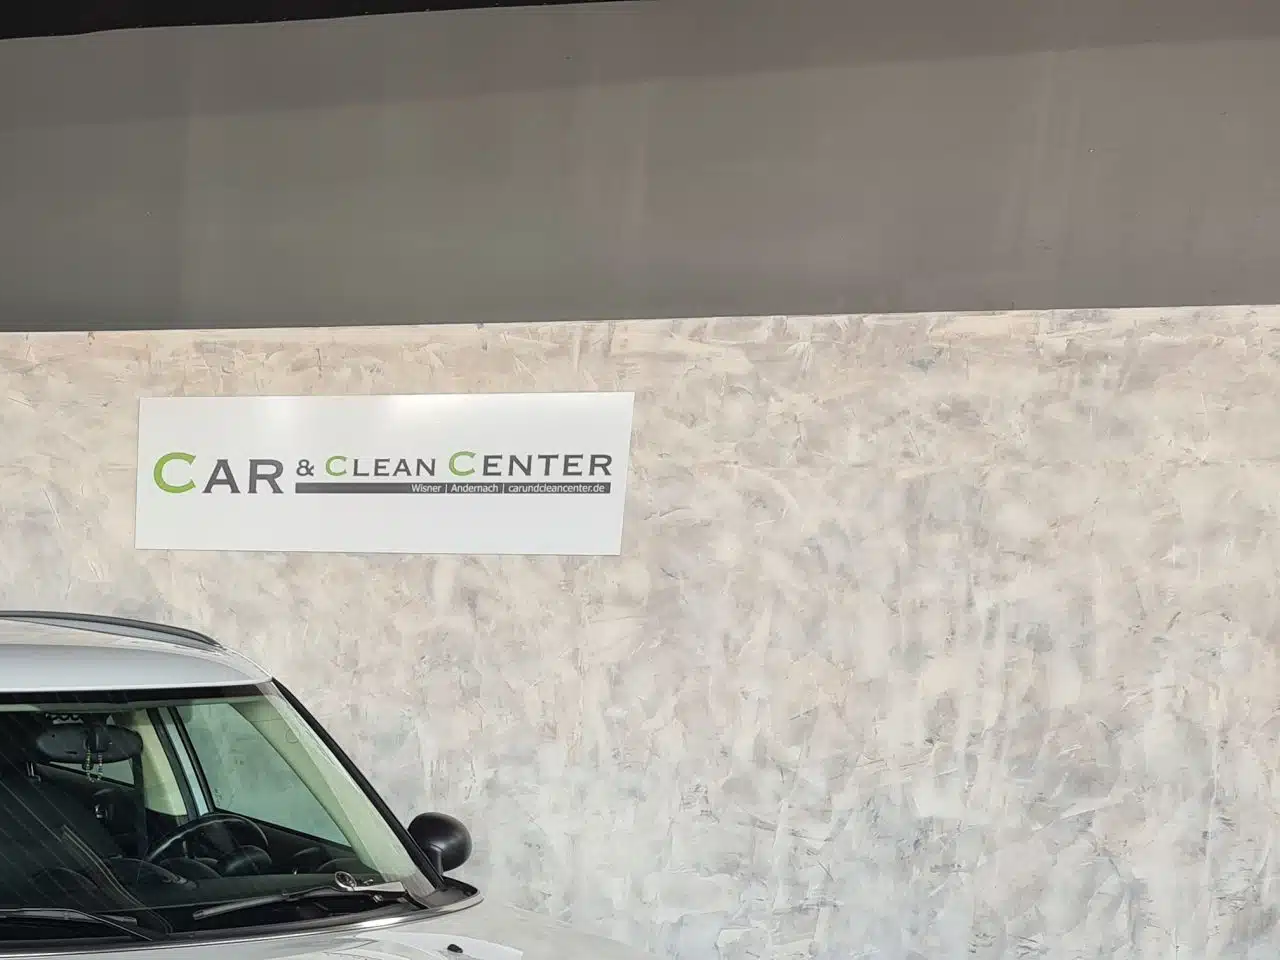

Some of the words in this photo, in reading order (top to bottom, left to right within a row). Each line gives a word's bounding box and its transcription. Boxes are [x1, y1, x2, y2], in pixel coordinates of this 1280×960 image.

[153, 452, 284, 494] CAR
[296, 459, 315, 477] &
[325, 455, 436, 477] CLEAN
[448, 451, 613, 477] CENTER
[411, 484, 441, 493] Wisner
[451, 483, 499, 493] Andernach
[508, 483, 605, 493] carundcleancenter.de
